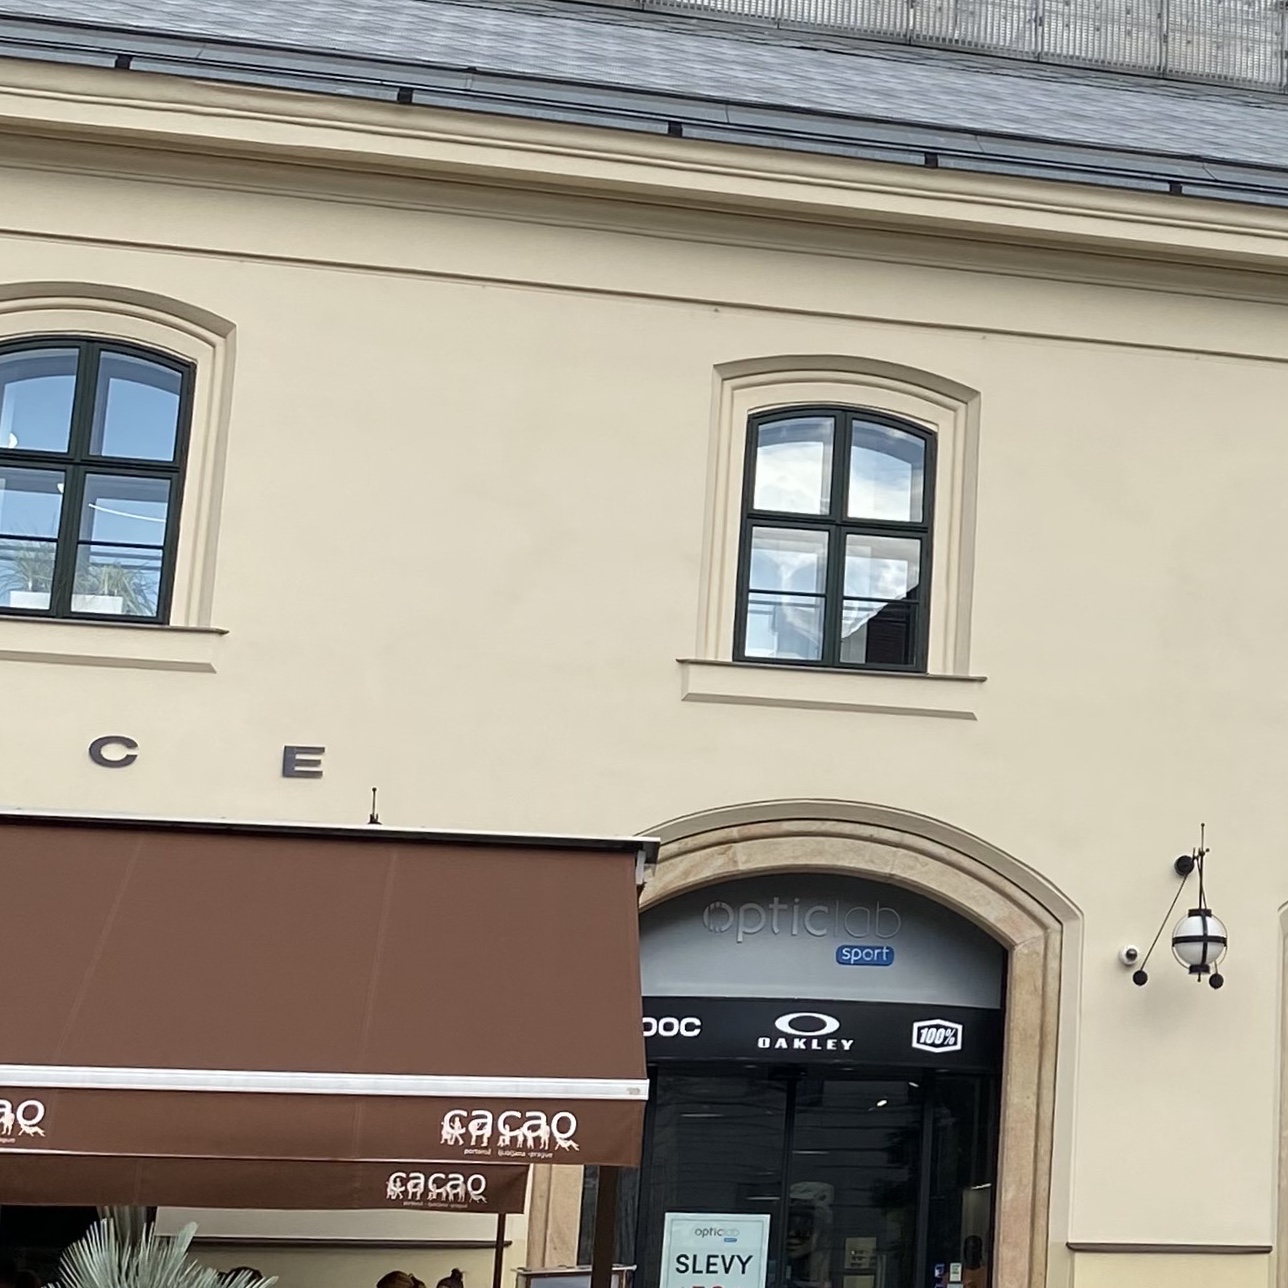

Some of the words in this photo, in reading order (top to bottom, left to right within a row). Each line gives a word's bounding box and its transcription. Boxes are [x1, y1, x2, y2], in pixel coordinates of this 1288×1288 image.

[842, 946, 890, 964] sport
[757, 1036, 854, 1051] OAKLEY
[918, 1027, 956, 1046] 100%
[442, 1109, 578, 1143] cacao
[388, 1172, 487, 1198] cacao
[675, 1254, 754, 1275] SLEVY
